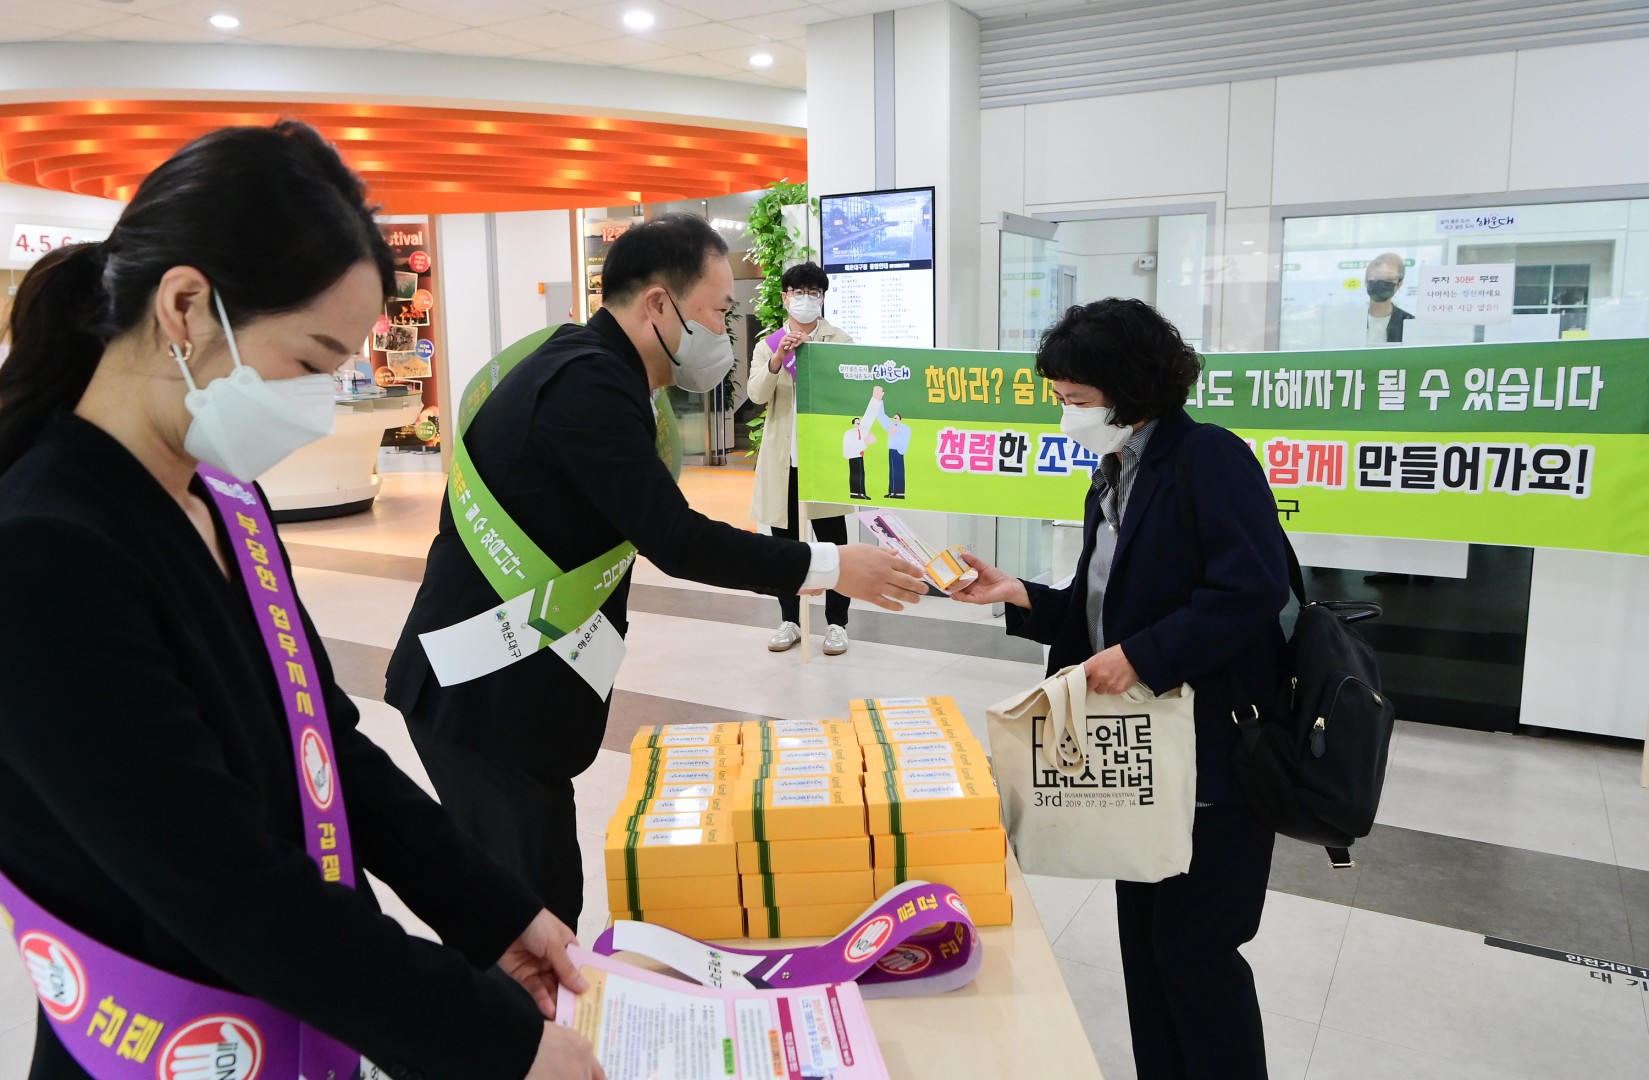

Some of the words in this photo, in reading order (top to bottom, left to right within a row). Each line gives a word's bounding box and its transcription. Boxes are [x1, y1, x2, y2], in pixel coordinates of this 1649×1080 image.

[1476, 214, 1514, 229] 해운대
[873, 364, 909, 382] 해운대
[924, 364, 1003, 405] 참아라?
[1245, 367, 1366, 411] 가해자가
[1378, 368, 1407, 411] 될
[1419, 368, 1451, 411] 수
[1462, 366, 1605, 412] 있습니다
[937, 429, 1028, 474] 청렴한
[1266, 440, 1344, 487] 함께
[1359, 444, 1590, 496] 만들어가요!
[480, 528, 527, 581] 있습니다!
[501, 620, 523, 659] 해운대구
[577, 613, 604, 650] 해운대구
[1034, 791, 1062, 807] 3rd
[317, 822, 341, 882] 갑질
[896, 892, 938, 924] 갑질
[1565, 954, 1632, 975] 안전거리
[86, 995, 165, 1065] 갑질
